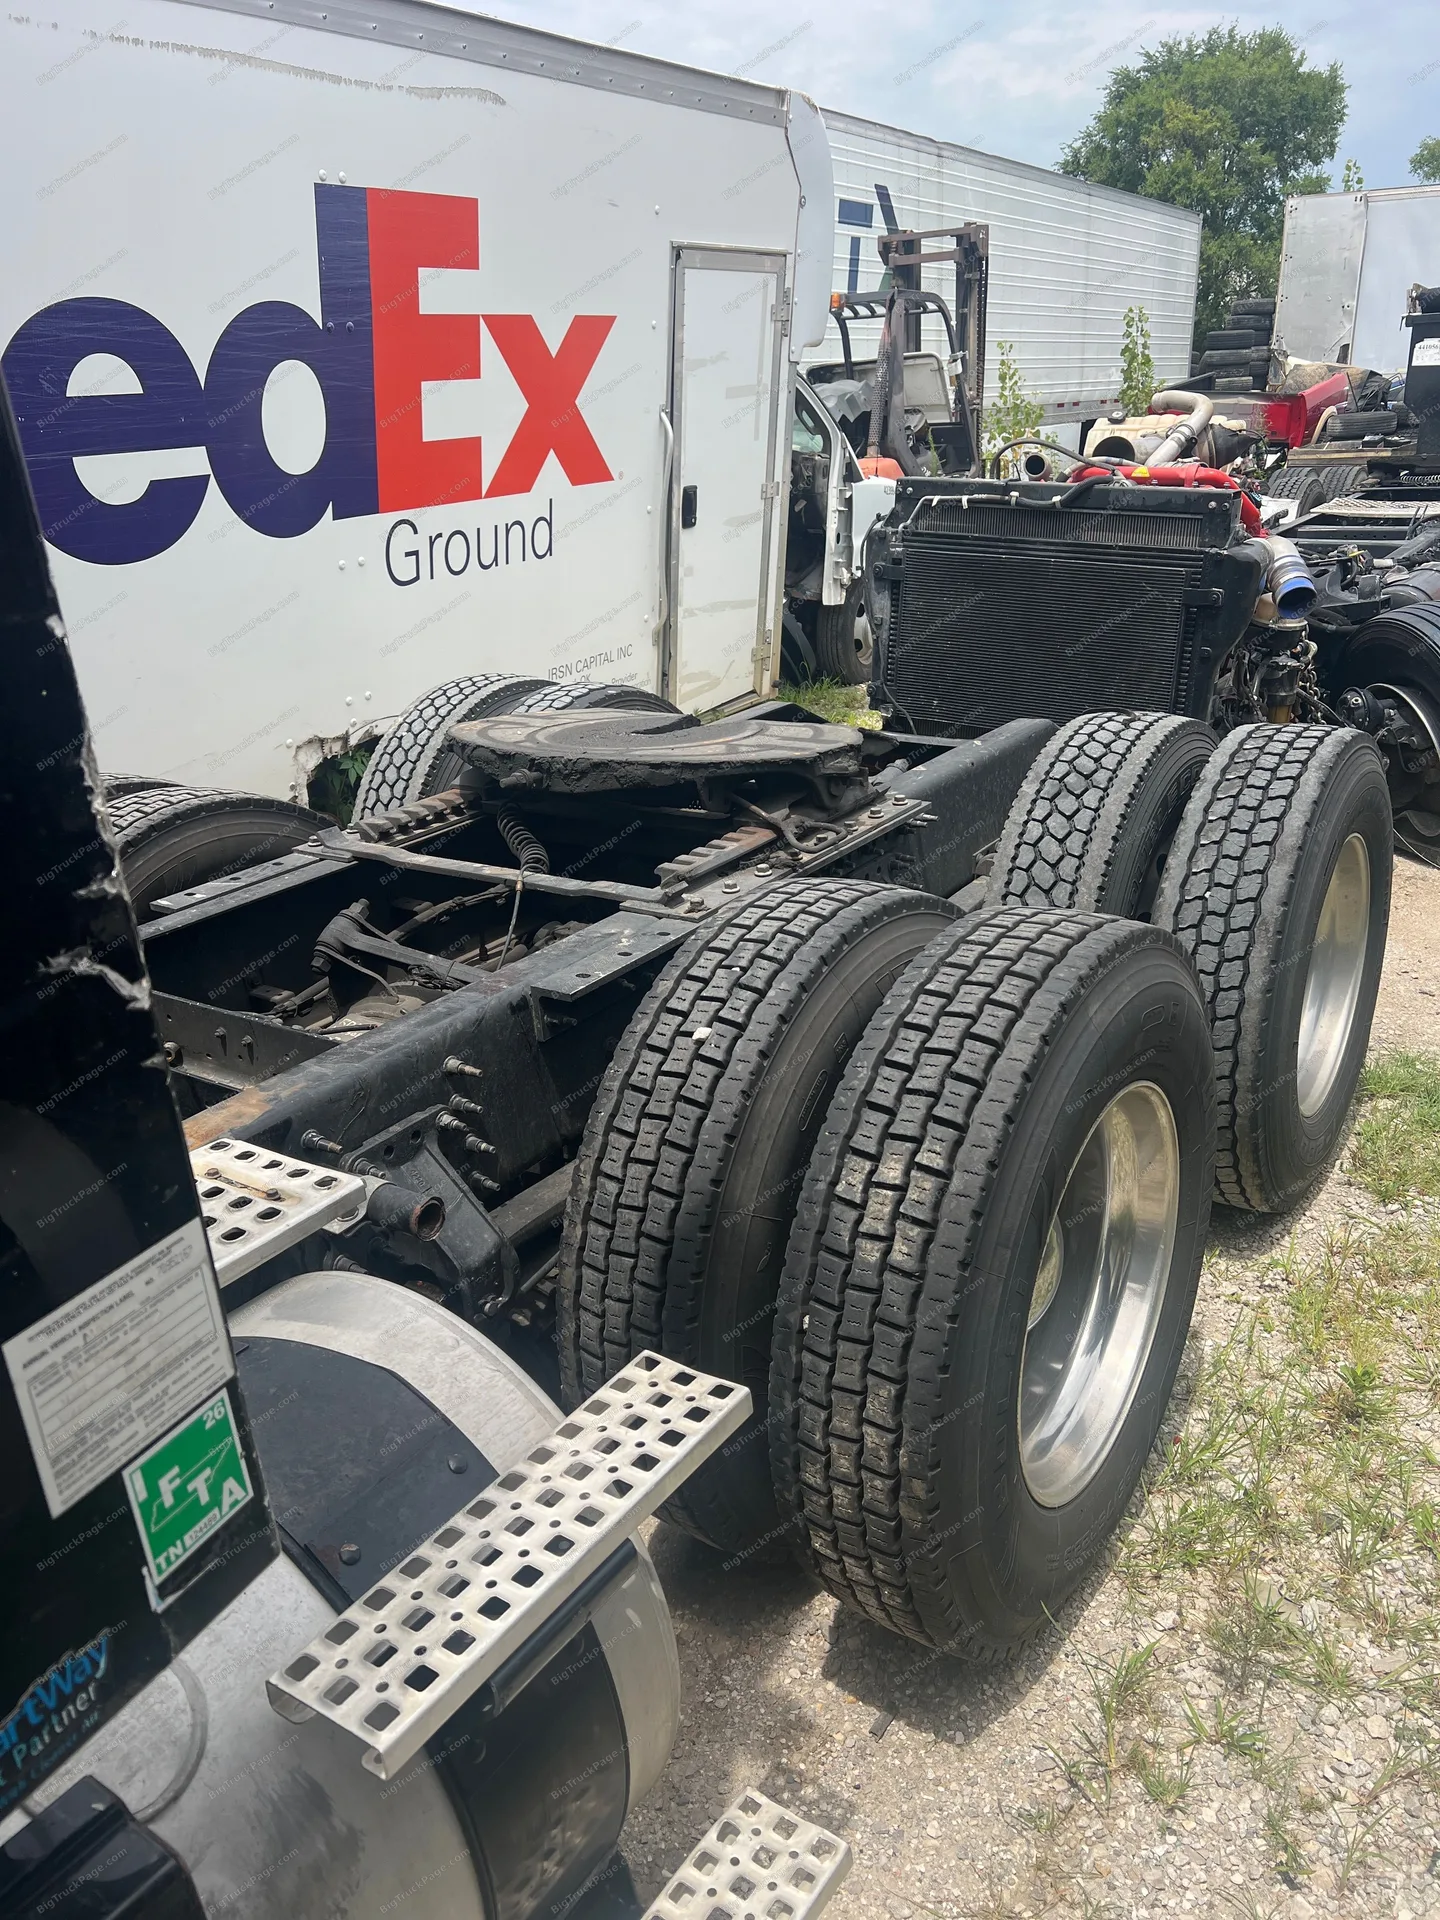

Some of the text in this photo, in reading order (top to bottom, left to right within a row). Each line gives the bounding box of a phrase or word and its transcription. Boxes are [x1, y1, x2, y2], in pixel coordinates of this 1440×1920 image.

[0, 183, 617, 565] edEx
[385, 499, 554, 587] Ground
[575, 650, 615, 673] CAPITAL
[617, 644, 633, 660] INC
[202, 1402, 226, 1430] 26
[154, 1538, 184, 1572] TN
[0, 1635, 108, 1758] artWay
[12, 1681, 98, 1771] Partner
